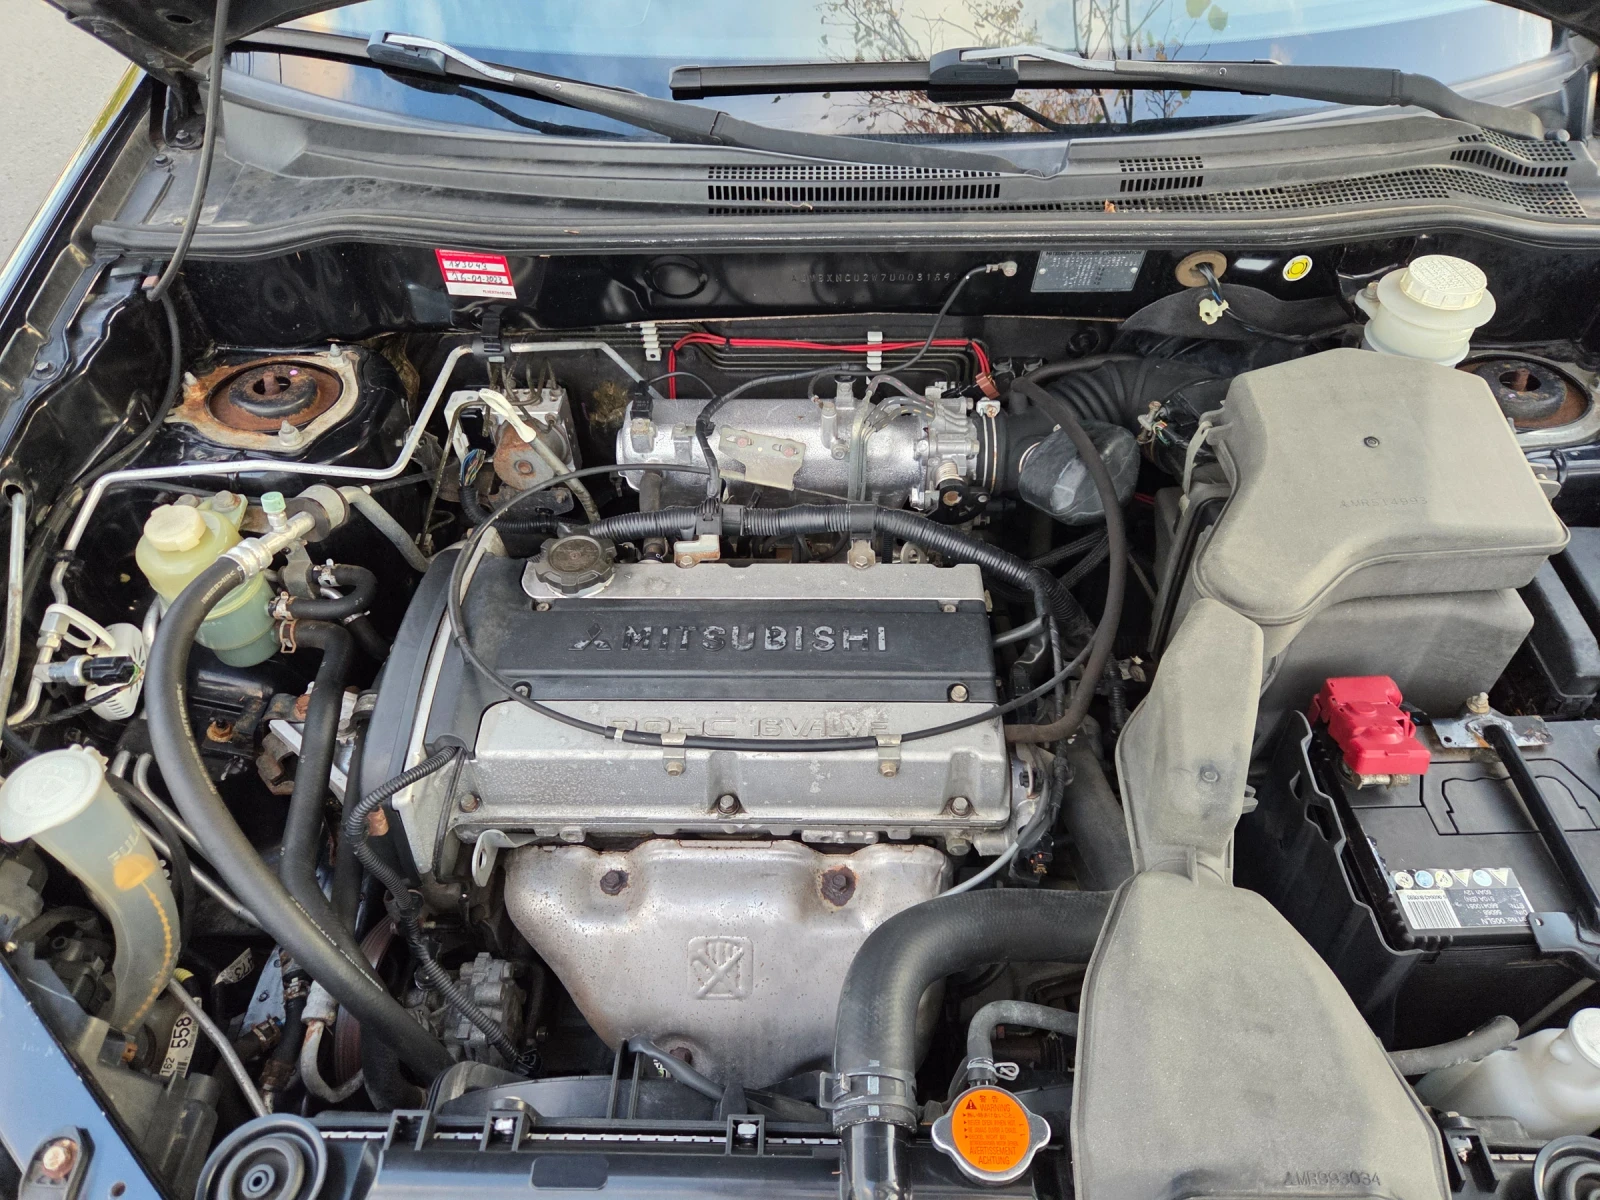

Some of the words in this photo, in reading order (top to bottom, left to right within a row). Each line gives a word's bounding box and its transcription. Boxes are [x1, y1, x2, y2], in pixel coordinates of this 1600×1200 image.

[620, 625, 887, 651] MITSUBISHI
[170, 1016, 192, 1049] 558
[160, 1057, 175, 1075] 162
[980, 1104, 1011, 1112] WARNING
[969, 1146, 1016, 1156] AVERTISSEMENT
[978, 1156, 1010, 1165] ACHTUNG
